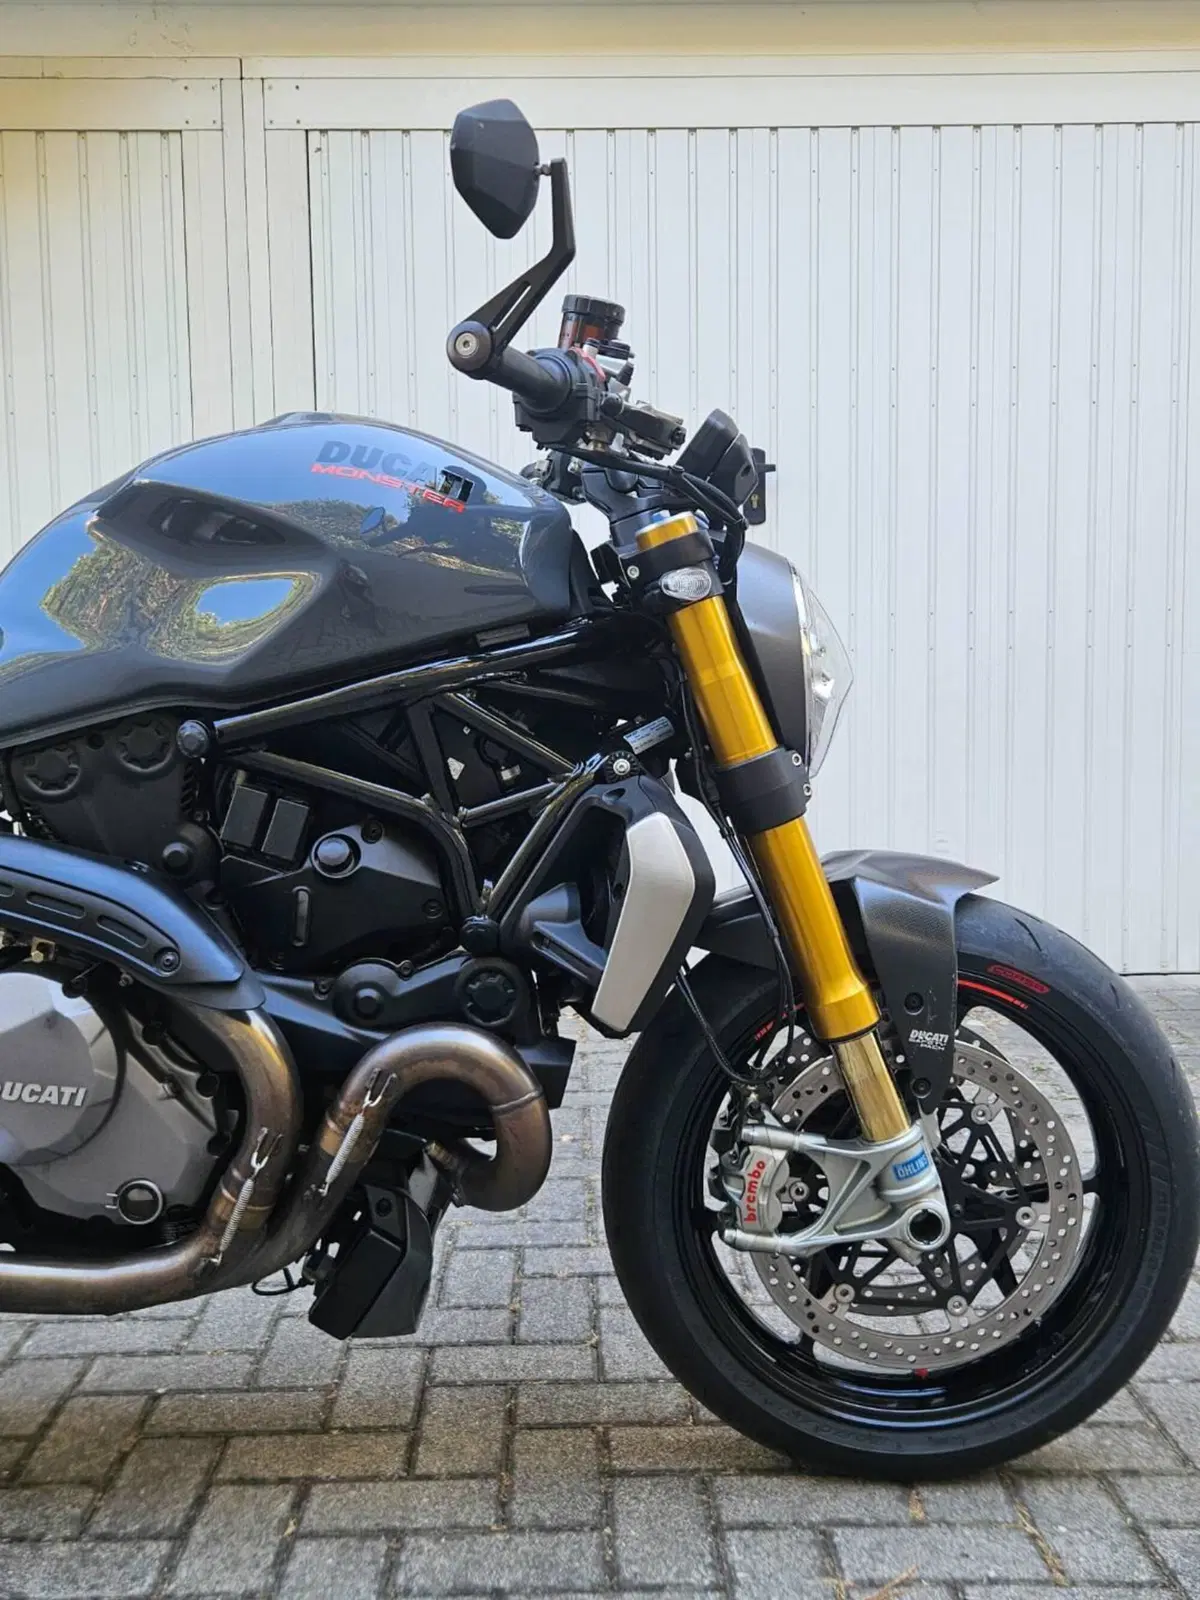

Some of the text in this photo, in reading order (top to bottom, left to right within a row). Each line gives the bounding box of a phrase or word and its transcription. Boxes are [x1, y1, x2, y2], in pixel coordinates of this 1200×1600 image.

[311, 462, 466, 514] MONSTER
[910, 1029, 949, 1043] DUCATI
[0, 1081, 87, 1107] UCATI
[744, 1160, 766, 1222] brembo
